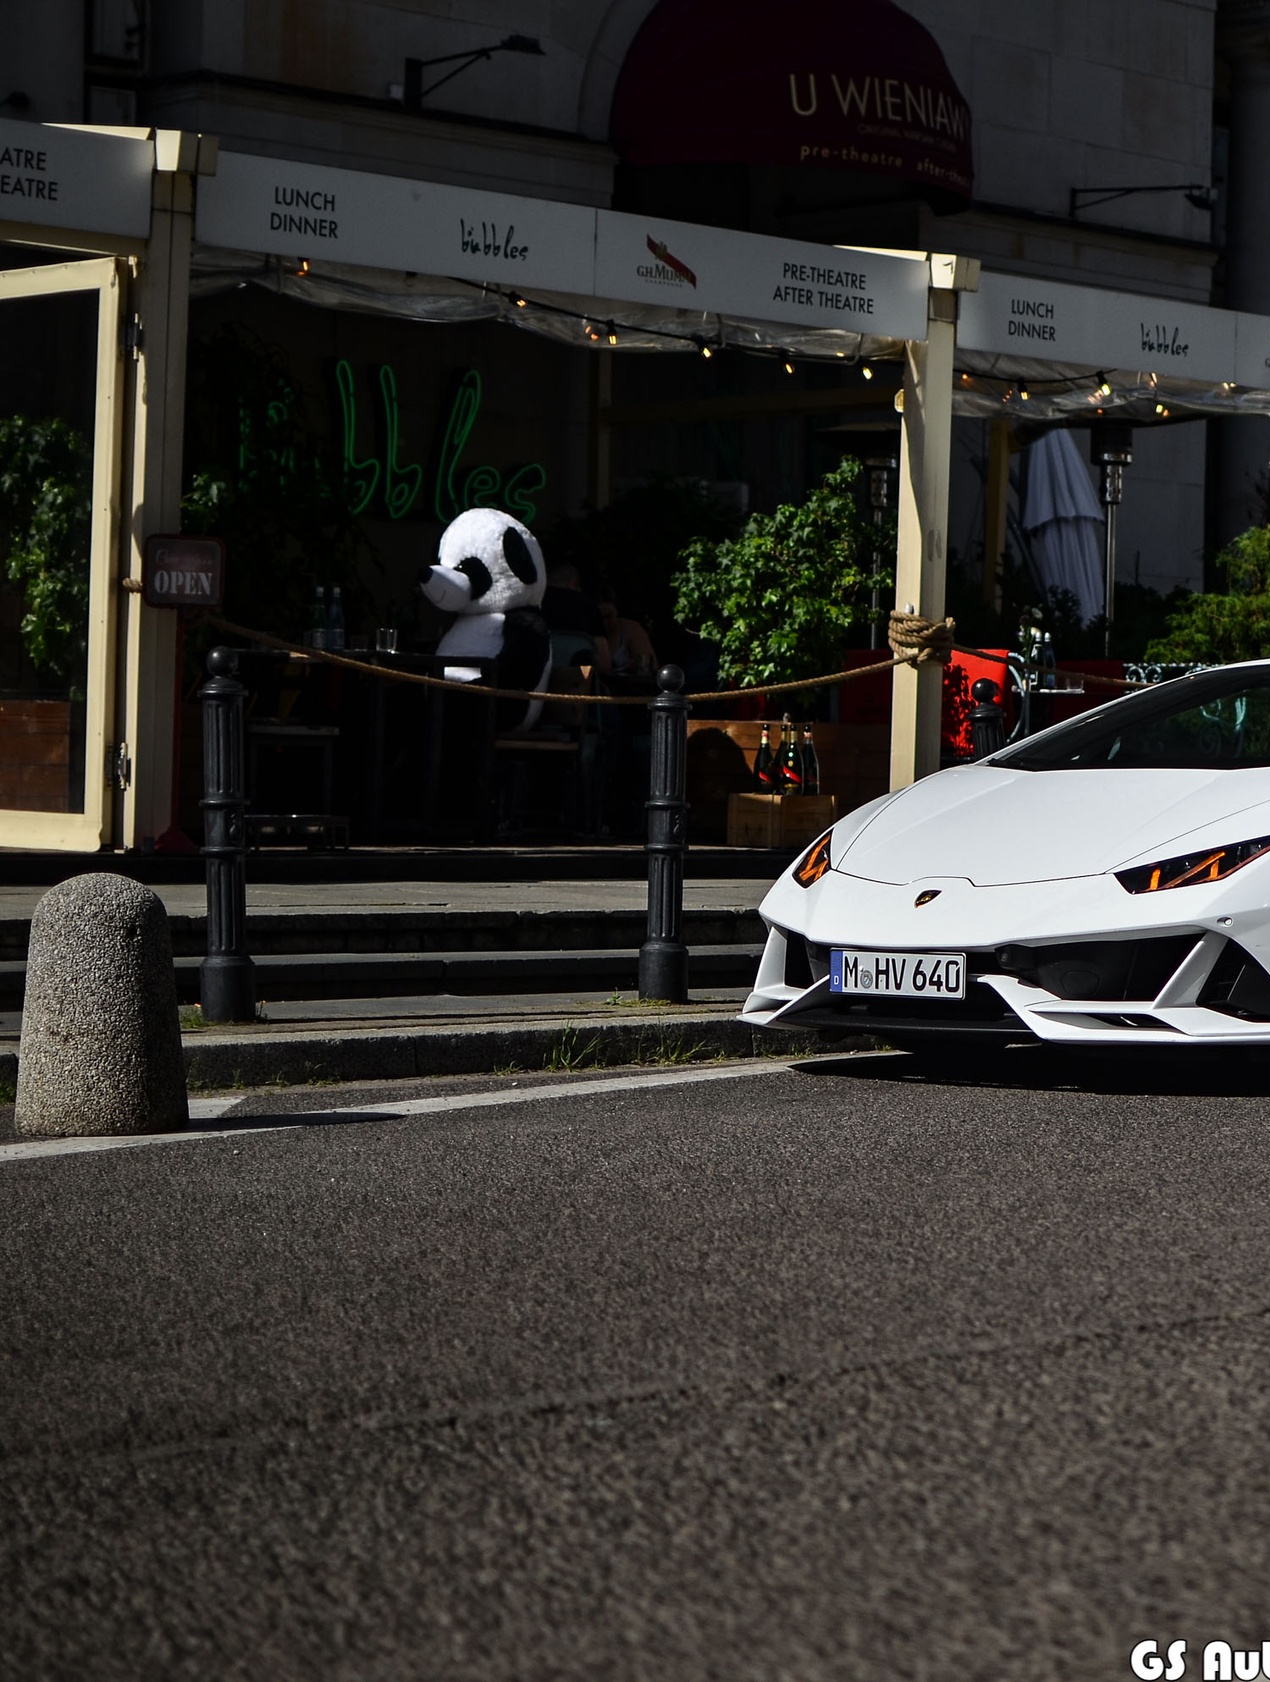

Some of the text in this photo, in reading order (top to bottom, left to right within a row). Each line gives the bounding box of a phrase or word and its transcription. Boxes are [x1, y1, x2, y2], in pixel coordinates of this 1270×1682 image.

[788, 73, 818, 117] U
[800, 144, 904, 170] pre-theatre
[1, 174, 58, 201] EATRE
[275, 186, 335, 212] LUNCH
[270, 212, 338, 239] DINNER
[783, 262, 866, 290] PRE-THEATRE
[773, 286, 874, 315] AFTER THEATRE
[1011, 299, 1054, 319] LUNCH
[1008, 320, 1056, 341] DINNER
[153, 569, 213, 597] OPEN
[833, 975, 840, 986] D
[843, 956, 960, 993] M HV 640
